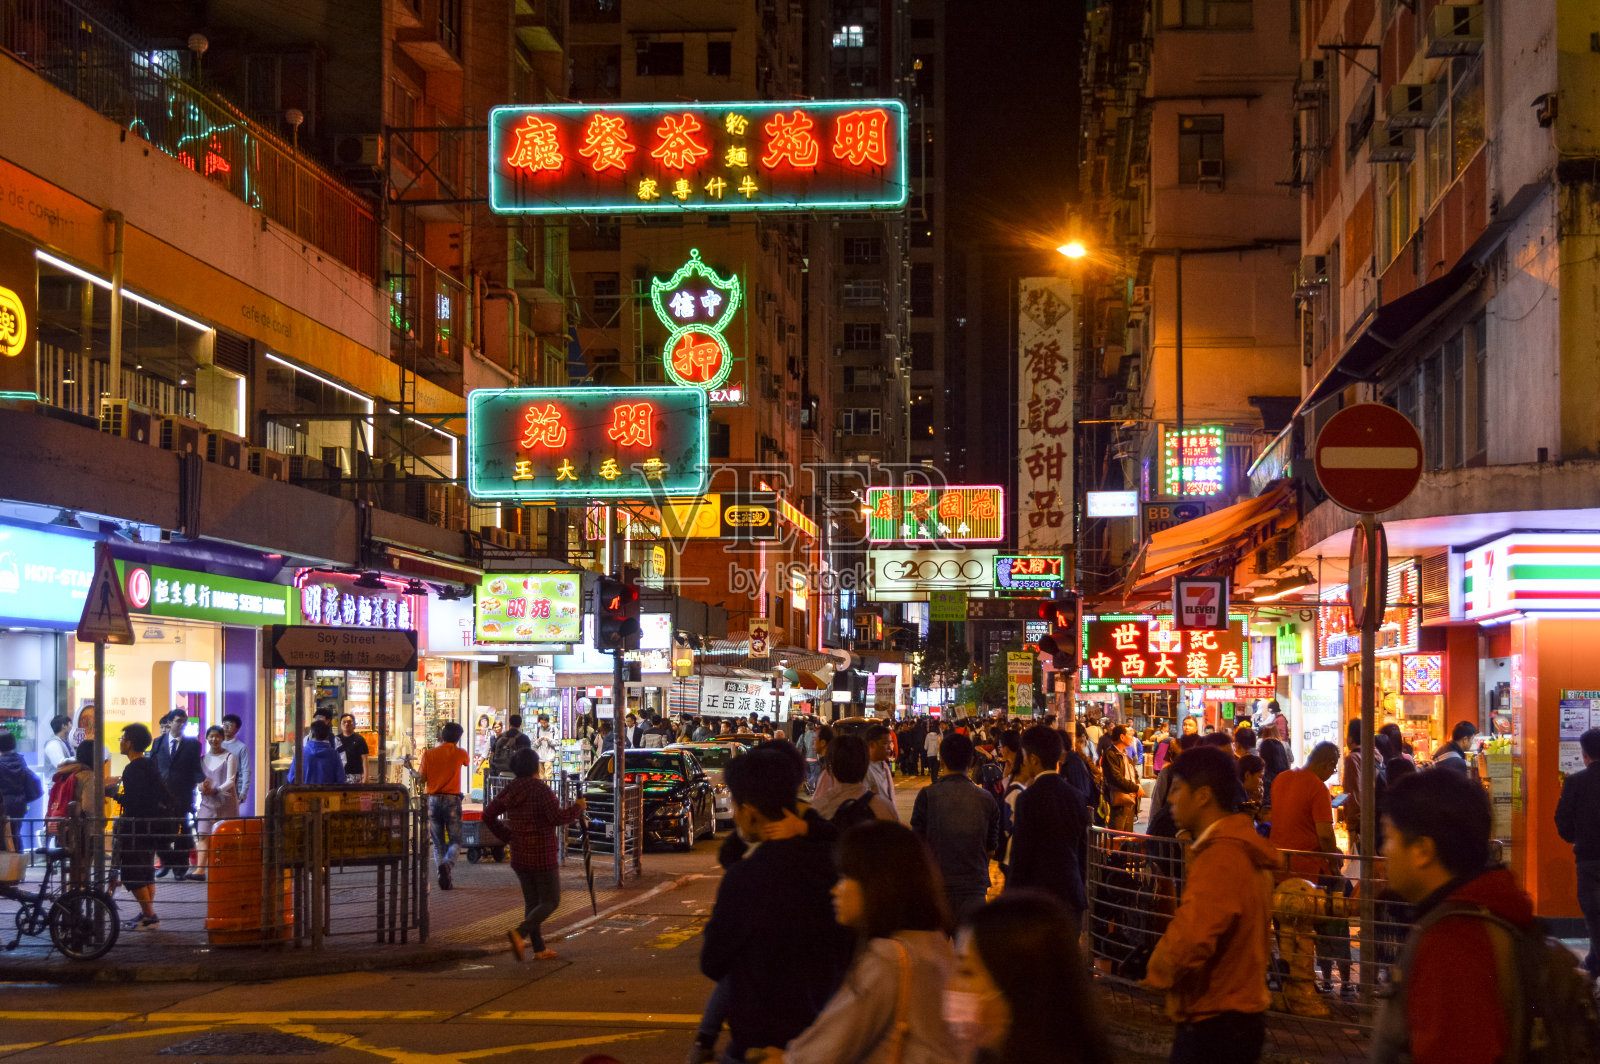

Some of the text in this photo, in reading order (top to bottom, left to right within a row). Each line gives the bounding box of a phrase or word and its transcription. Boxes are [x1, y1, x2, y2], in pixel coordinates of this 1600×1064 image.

[673, 334, 721, 382] 押
[1148, 507, 1171, 520] BB
[883, 560, 984, 581] G2000
[507, 597, 551, 619] 明苑
[317, 632, 376, 645] Soy Street
[1090, 651, 1241, 679] 中西大藥房
